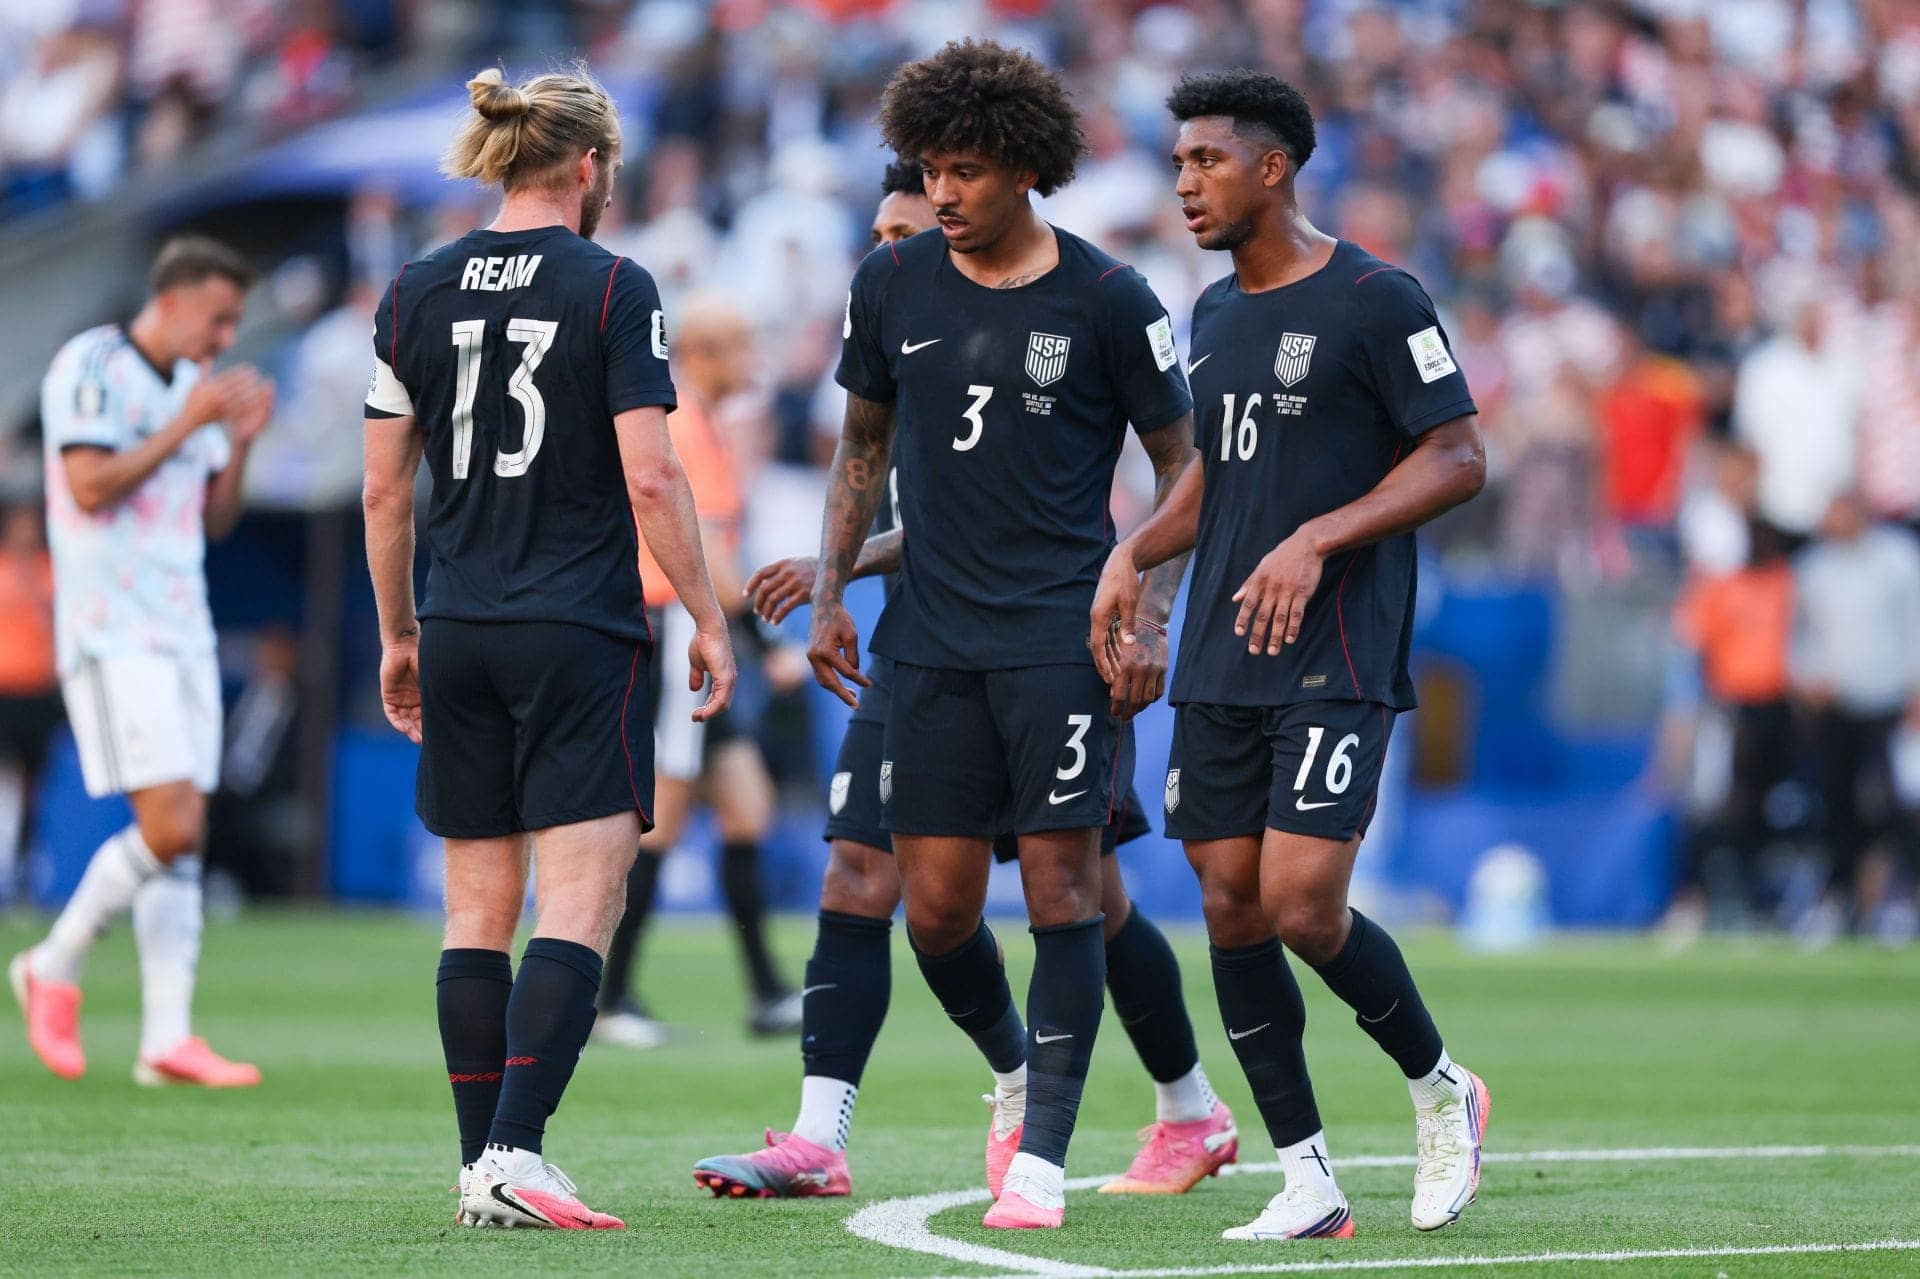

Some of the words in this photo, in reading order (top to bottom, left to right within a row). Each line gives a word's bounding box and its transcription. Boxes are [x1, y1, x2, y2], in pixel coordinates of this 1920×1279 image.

[460, 255, 543, 291] REAM
[1032, 334, 1066, 358] USA
[1282, 336, 1312, 357] USA
[452, 318, 559, 479] 13
[952, 385, 994, 451] 3
[1220, 393, 1262, 461] 16
[1056, 715, 1092, 780] 3
[1293, 727, 1360, 795] 16
